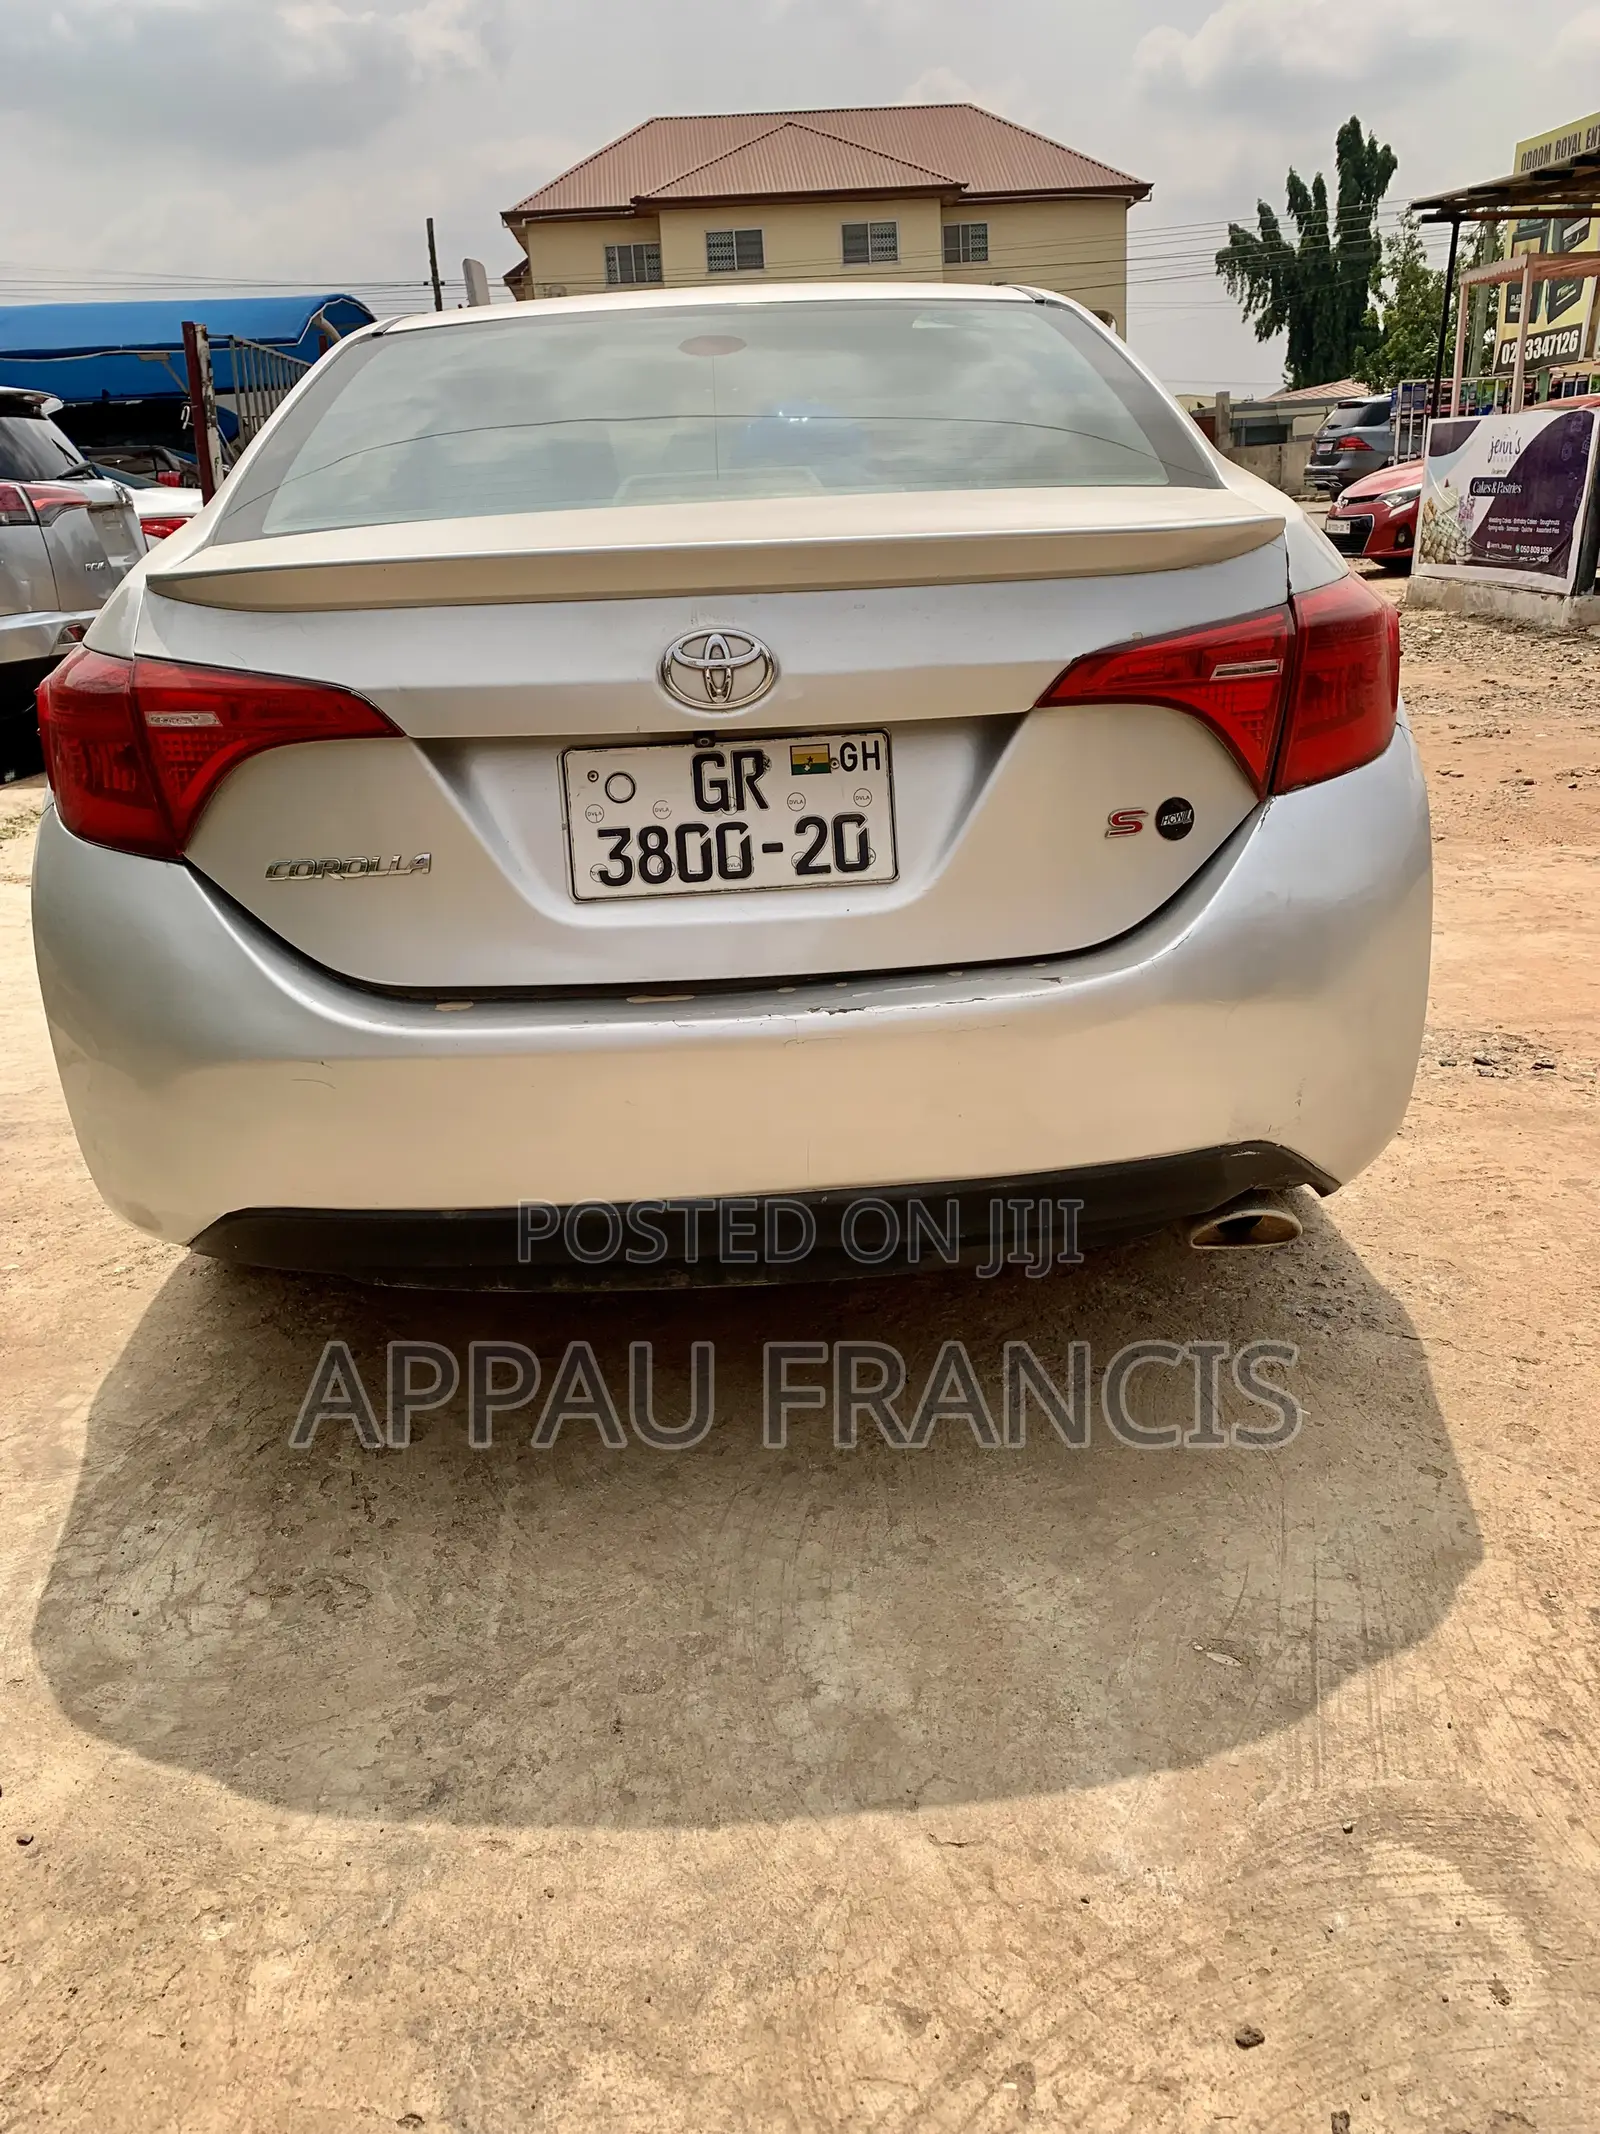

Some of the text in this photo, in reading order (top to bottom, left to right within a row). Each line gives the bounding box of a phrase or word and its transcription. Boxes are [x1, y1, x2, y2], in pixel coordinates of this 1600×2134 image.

[1555, 132, 1581, 160] ROYAL
[1501, 329, 1579, 364] 023347126
[1472, 481, 1523, 494] Cakes & Pastries
[690, 740, 881, 813] GR GH
[789, 797, 804, 806] DVLA
[854, 793, 871, 802] DVLA
[1104, 807, 1149, 838] S
[597, 814, 871, 887] 3800-20
[265, 852, 432, 881] COROLLA
